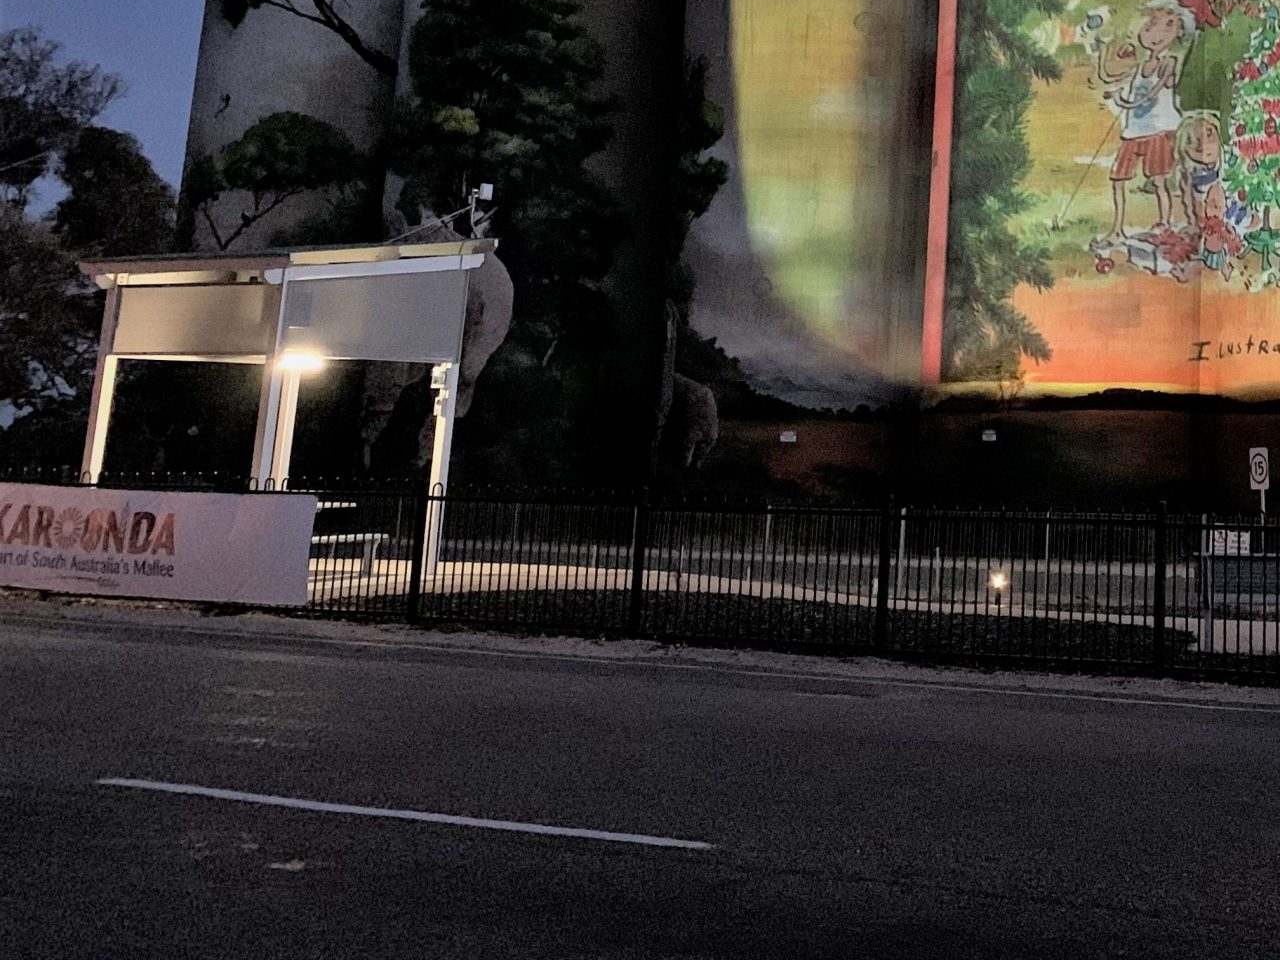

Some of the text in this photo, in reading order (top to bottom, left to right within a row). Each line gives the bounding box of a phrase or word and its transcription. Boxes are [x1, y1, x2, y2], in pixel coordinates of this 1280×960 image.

[1254, 461, 1264, 476] 15
[16, 550, 29, 566] of
[32, 551, 66, 570] South
[71, 556, 129, 575] Australia's
[133, 560, 174, 578] Mallee
